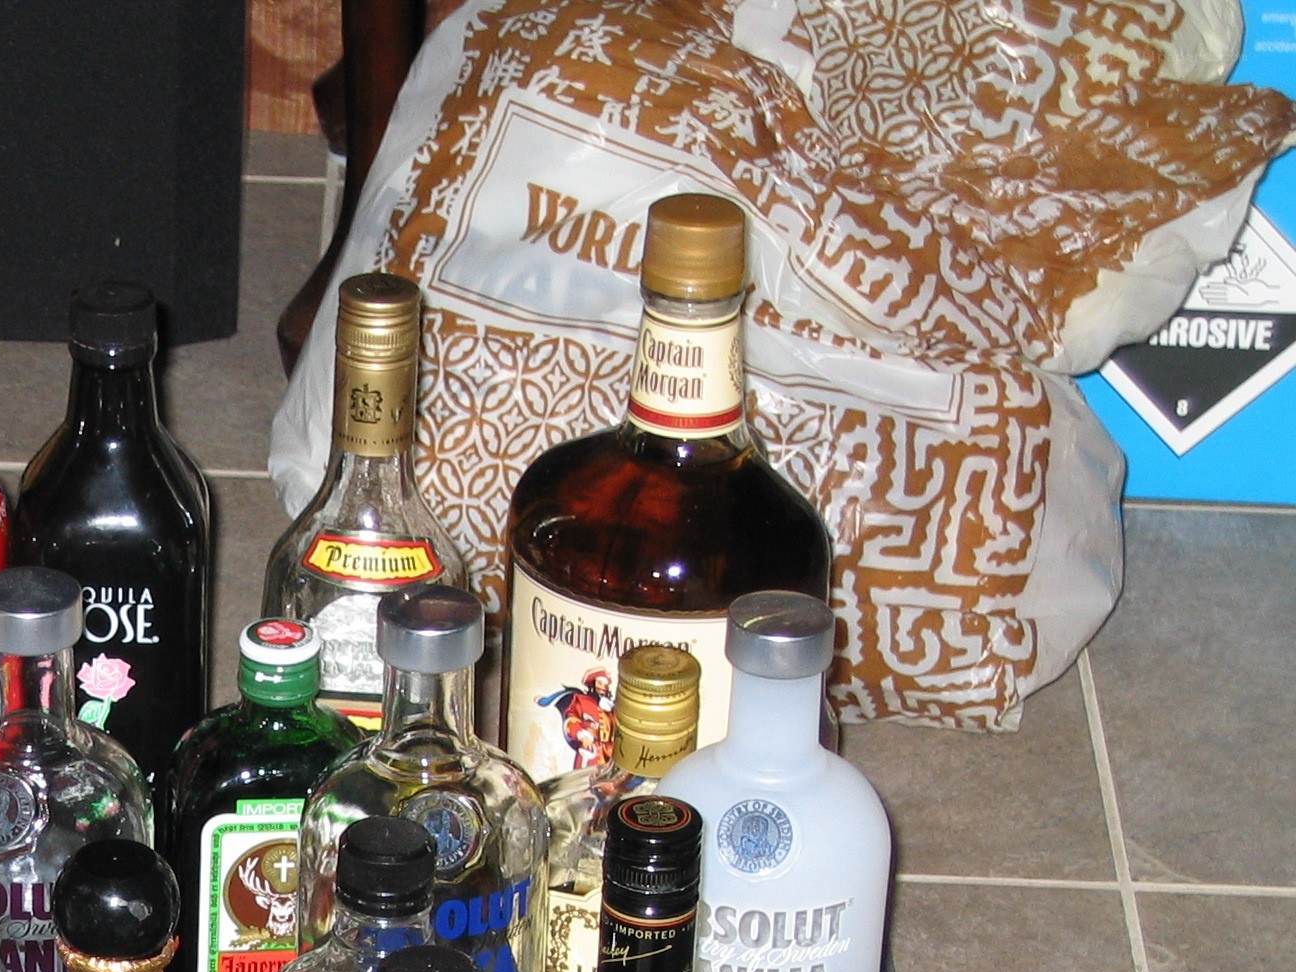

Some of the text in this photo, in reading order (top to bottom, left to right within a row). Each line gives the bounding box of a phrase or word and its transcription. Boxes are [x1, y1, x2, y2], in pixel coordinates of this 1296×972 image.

[520, 183, 642, 276] WORL
[642, 328, 704, 369] Captain
[1149, 316, 1273, 350] ROSIVE
[635, 362, 704, 402] Morgan
[1176, 399, 1189, 417] 8
[326, 545, 416, 573] Premium
[83, 587, 153, 604] QUILA
[532, 596, 597, 653] Captain
[242, 803, 304, 815] IMPOR
[434, 879, 532, 940] OLUT
[698, 899, 847, 948] BSOLUT
[615, 923, 676, 940] IMPORTED
[767, 937, 851, 967] Sweden
